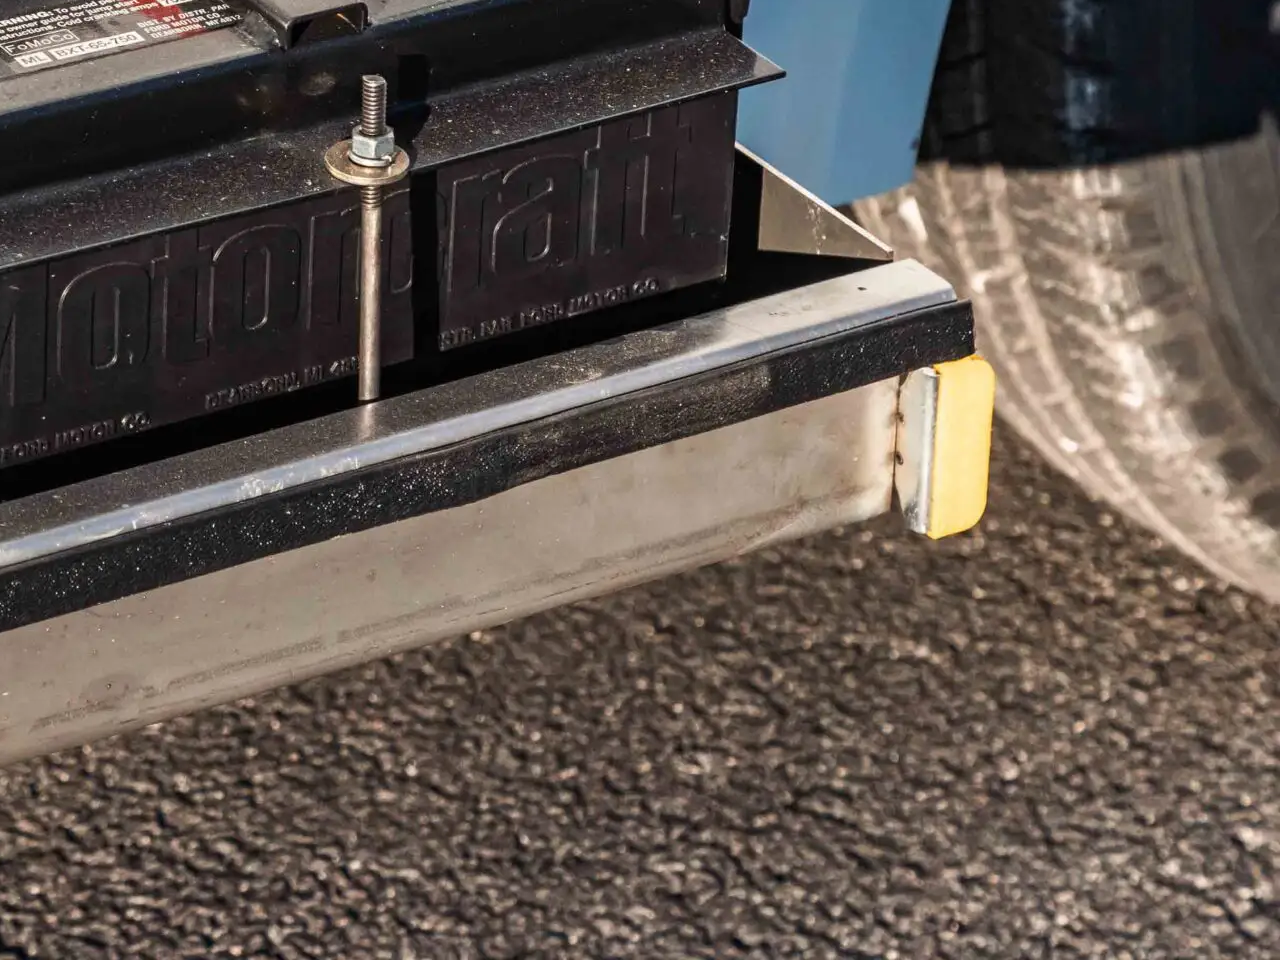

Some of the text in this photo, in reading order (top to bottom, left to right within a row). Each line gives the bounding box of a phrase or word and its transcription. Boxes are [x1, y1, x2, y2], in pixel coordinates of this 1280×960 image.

[54, 7, 68, 15] To
[70, 0, 98, 11] avoid
[57, 17, 82, 27] Cold
[83, 7, 130, 23] cranking
[130, 2, 159, 12] amps
[179, 8, 210, 19] DISTR.
[7, 21, 39, 31] owner
[40, 13, 70, 25] guide
[70, 10, 85, 19] for
[86, 5, 113, 16] jump
[144, 25, 170, 33] FORD
[171, 16, 206, 27] MOTOR
[4, 33, 74, 53] FoMoCo
[55, 34, 138, 56] BXT-65-750
